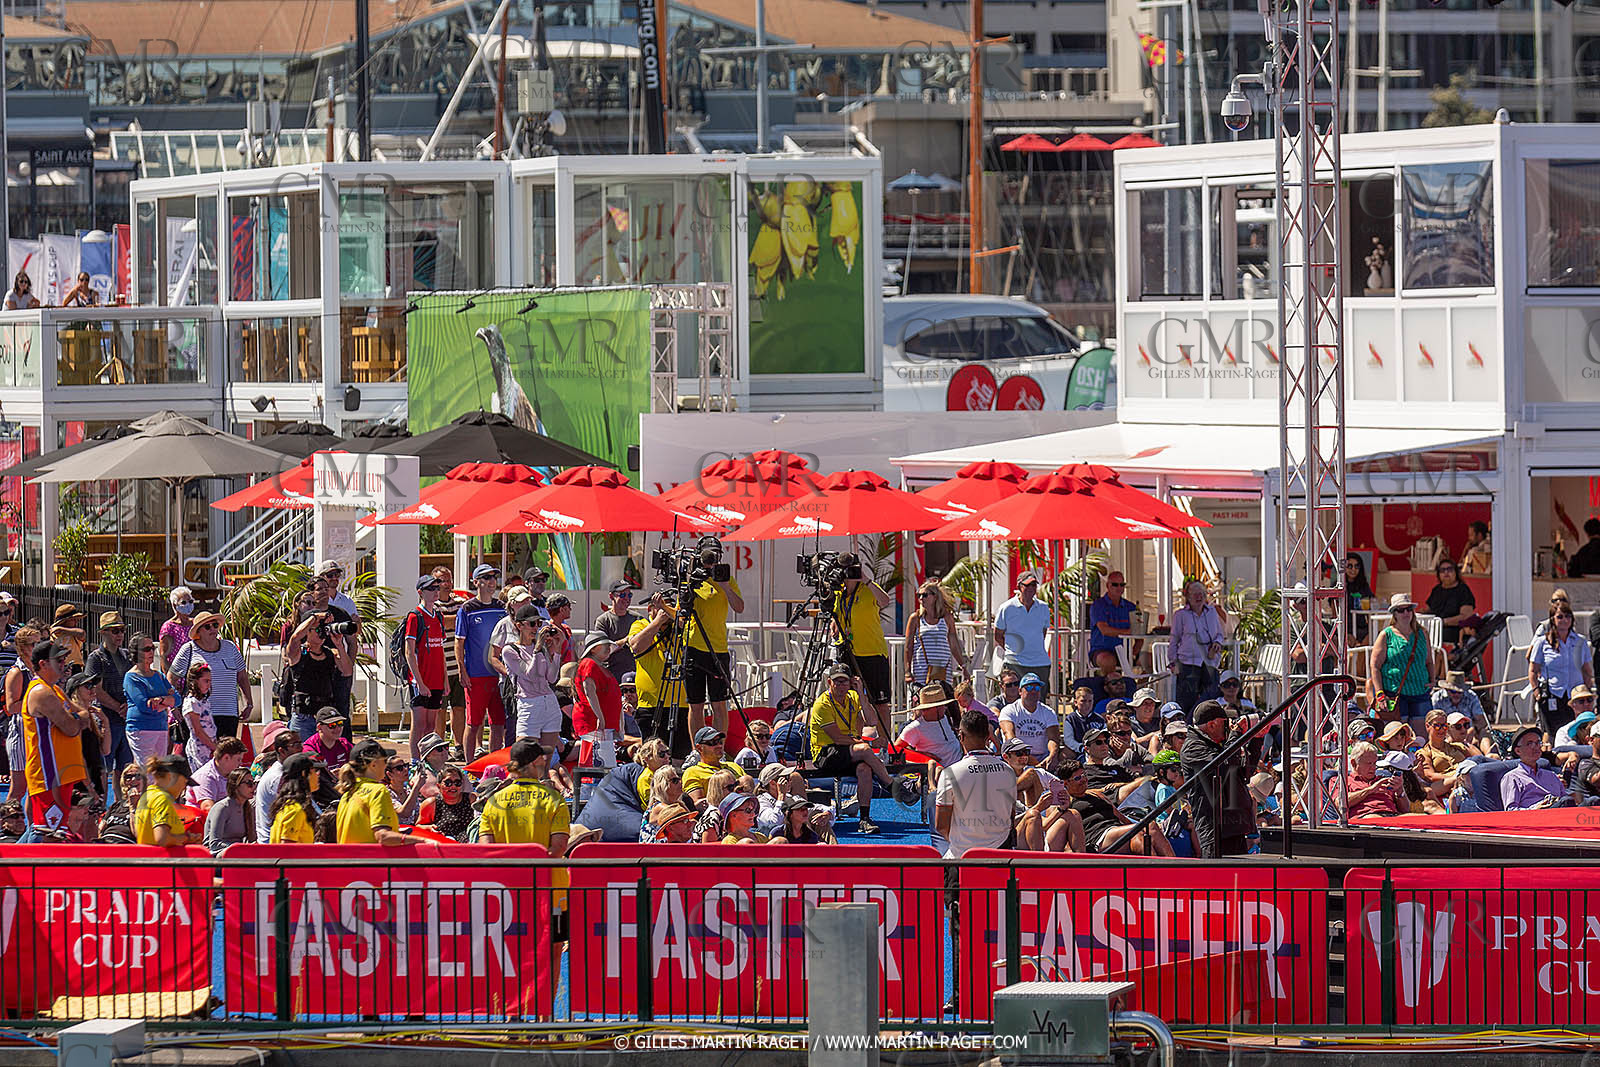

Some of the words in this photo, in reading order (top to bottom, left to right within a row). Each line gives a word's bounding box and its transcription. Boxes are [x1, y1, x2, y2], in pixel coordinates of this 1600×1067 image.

[34, 150, 63, 163] SAINT
[67, 150, 92, 163] ALICE
[967, 763, 1006, 774] SECURITY
[528, 790, 551, 800] TEAM
[41, 890, 192, 925] PRADA
[254, 881, 516, 977] FASTER
[73, 934, 160, 969] CUP
